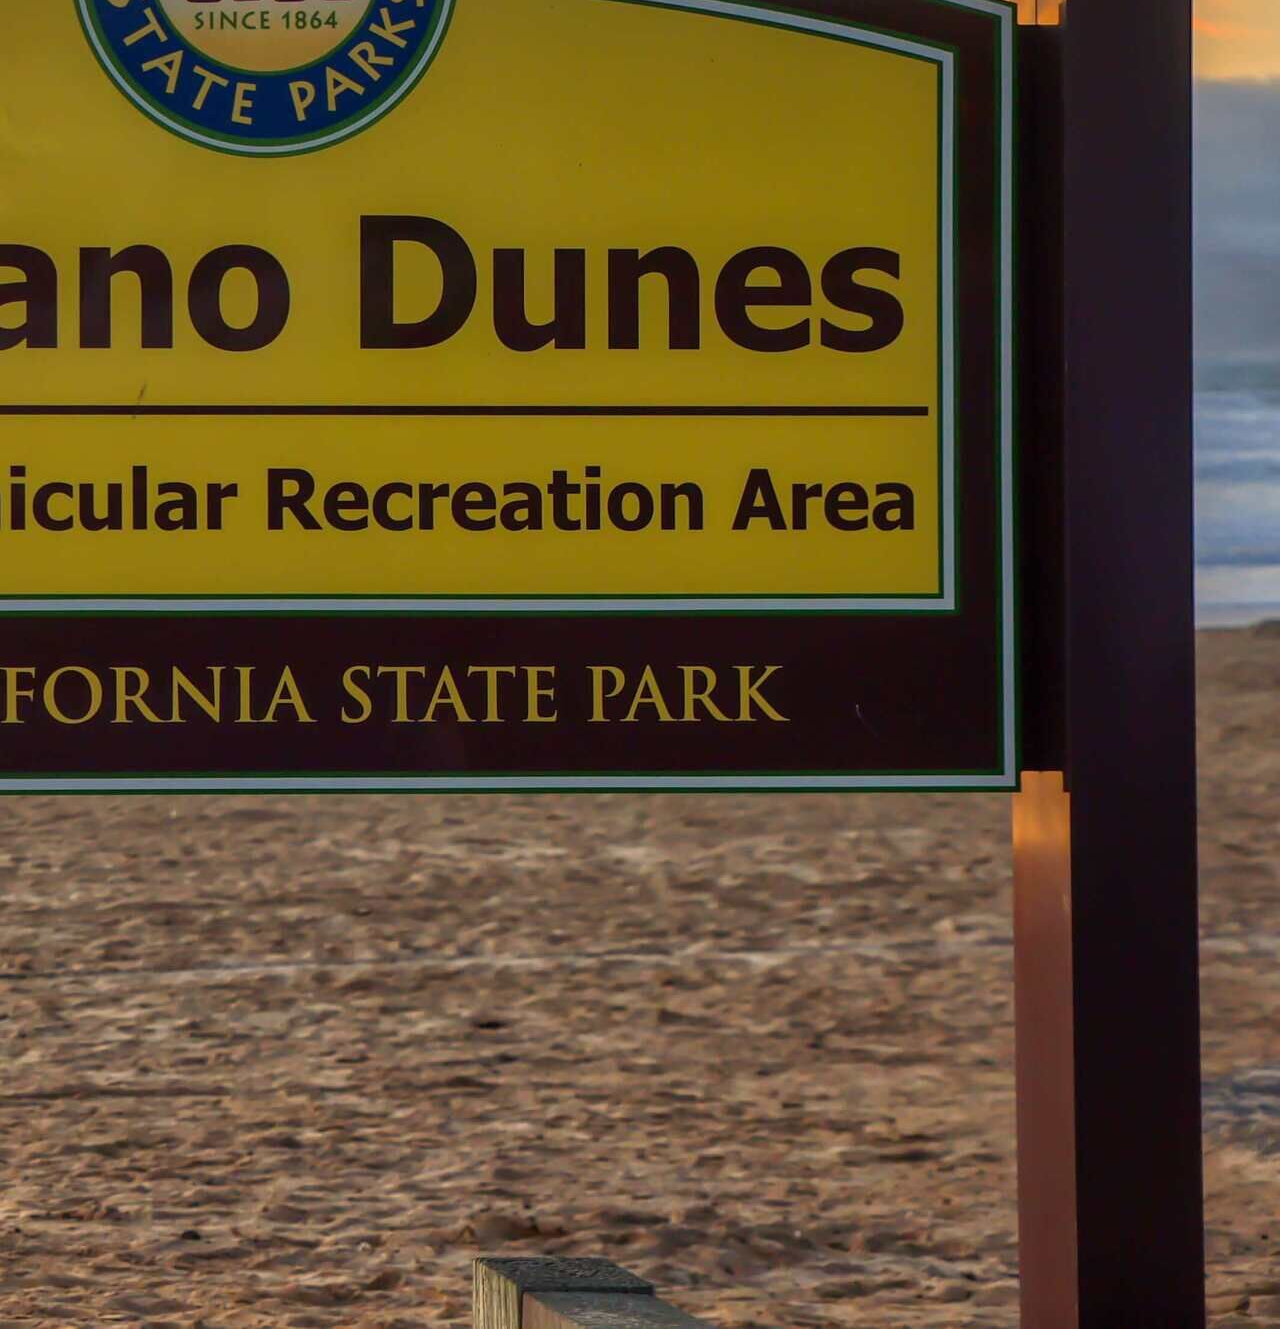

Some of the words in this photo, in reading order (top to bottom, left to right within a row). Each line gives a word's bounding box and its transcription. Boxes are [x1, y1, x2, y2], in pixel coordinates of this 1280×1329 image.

[194, 10, 271, 30] SINCE
[281, 10, 339, 30] 1864
[359, 215, 905, 353] Dunes
[266, 465, 705, 533] Recreation
[731, 467, 915, 532] Area
[341, 665, 557, 723] STATE
[586, 665, 790, 722] PARK
